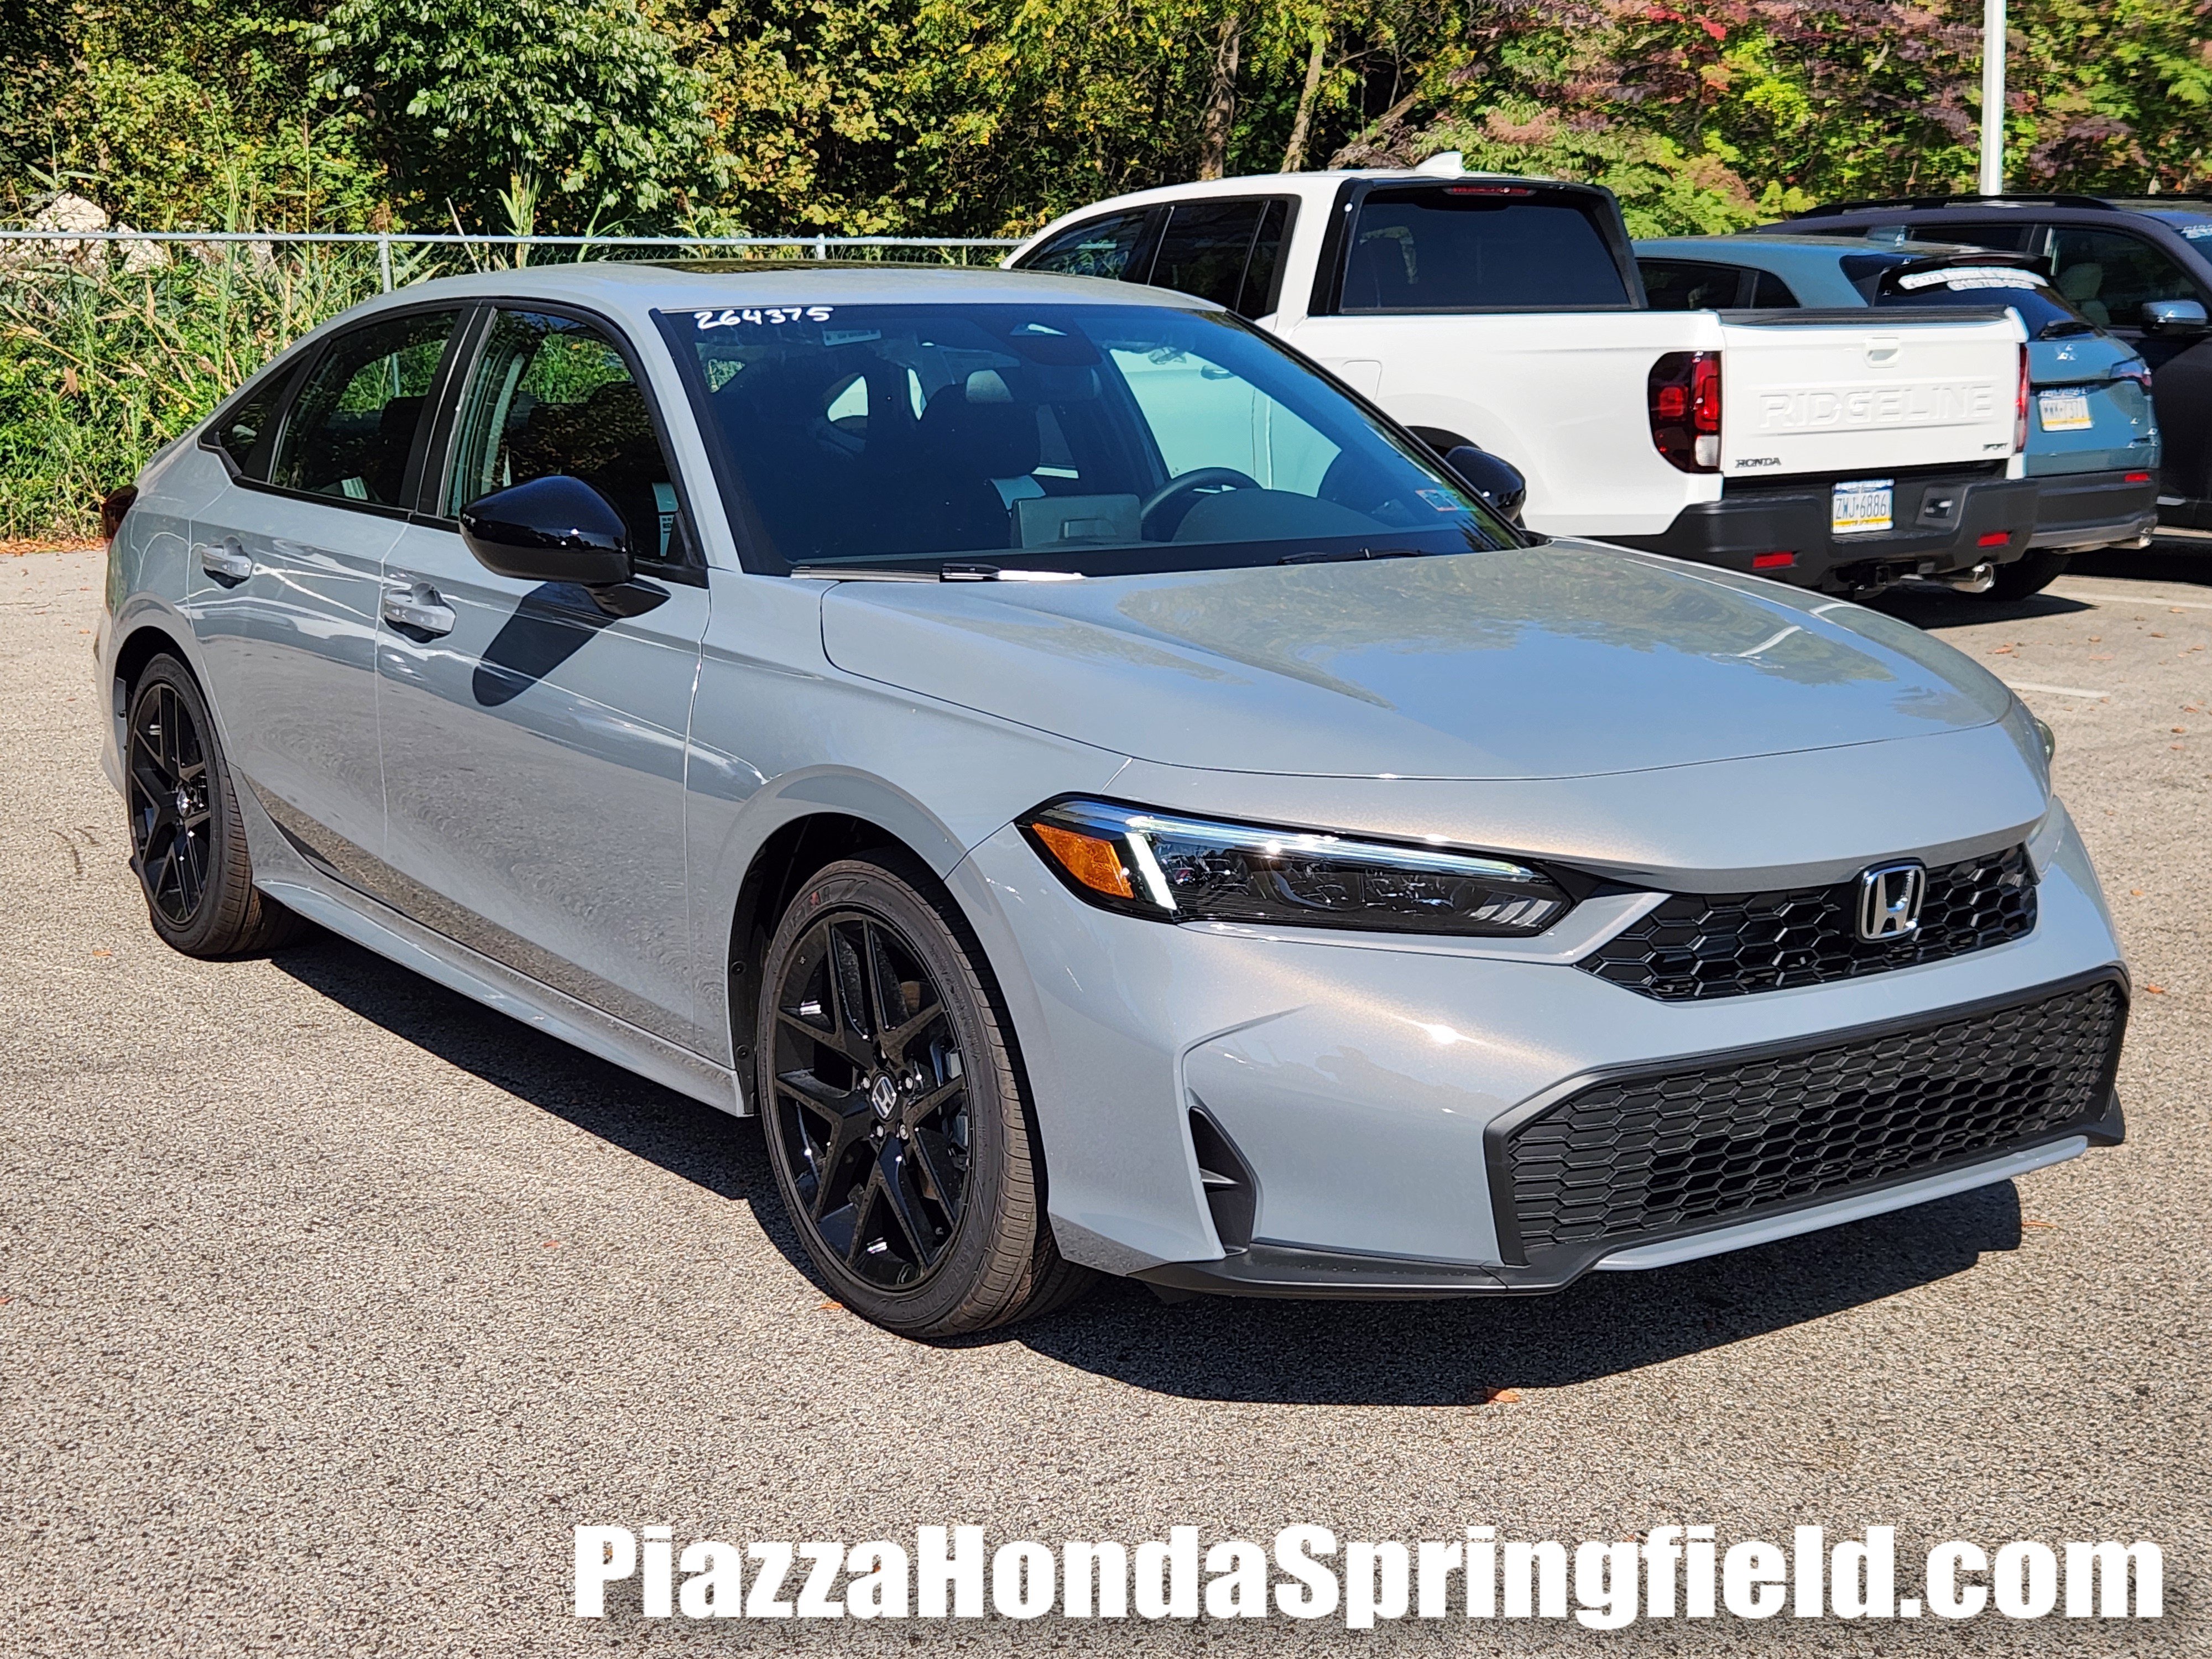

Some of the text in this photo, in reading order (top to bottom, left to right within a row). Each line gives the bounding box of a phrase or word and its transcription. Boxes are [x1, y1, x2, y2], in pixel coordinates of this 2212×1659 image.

[693, 307, 834, 330] 264375
[1759, 386, 1994, 428] RIDGELINE
[1735, 457, 1782, 468] HONDA
